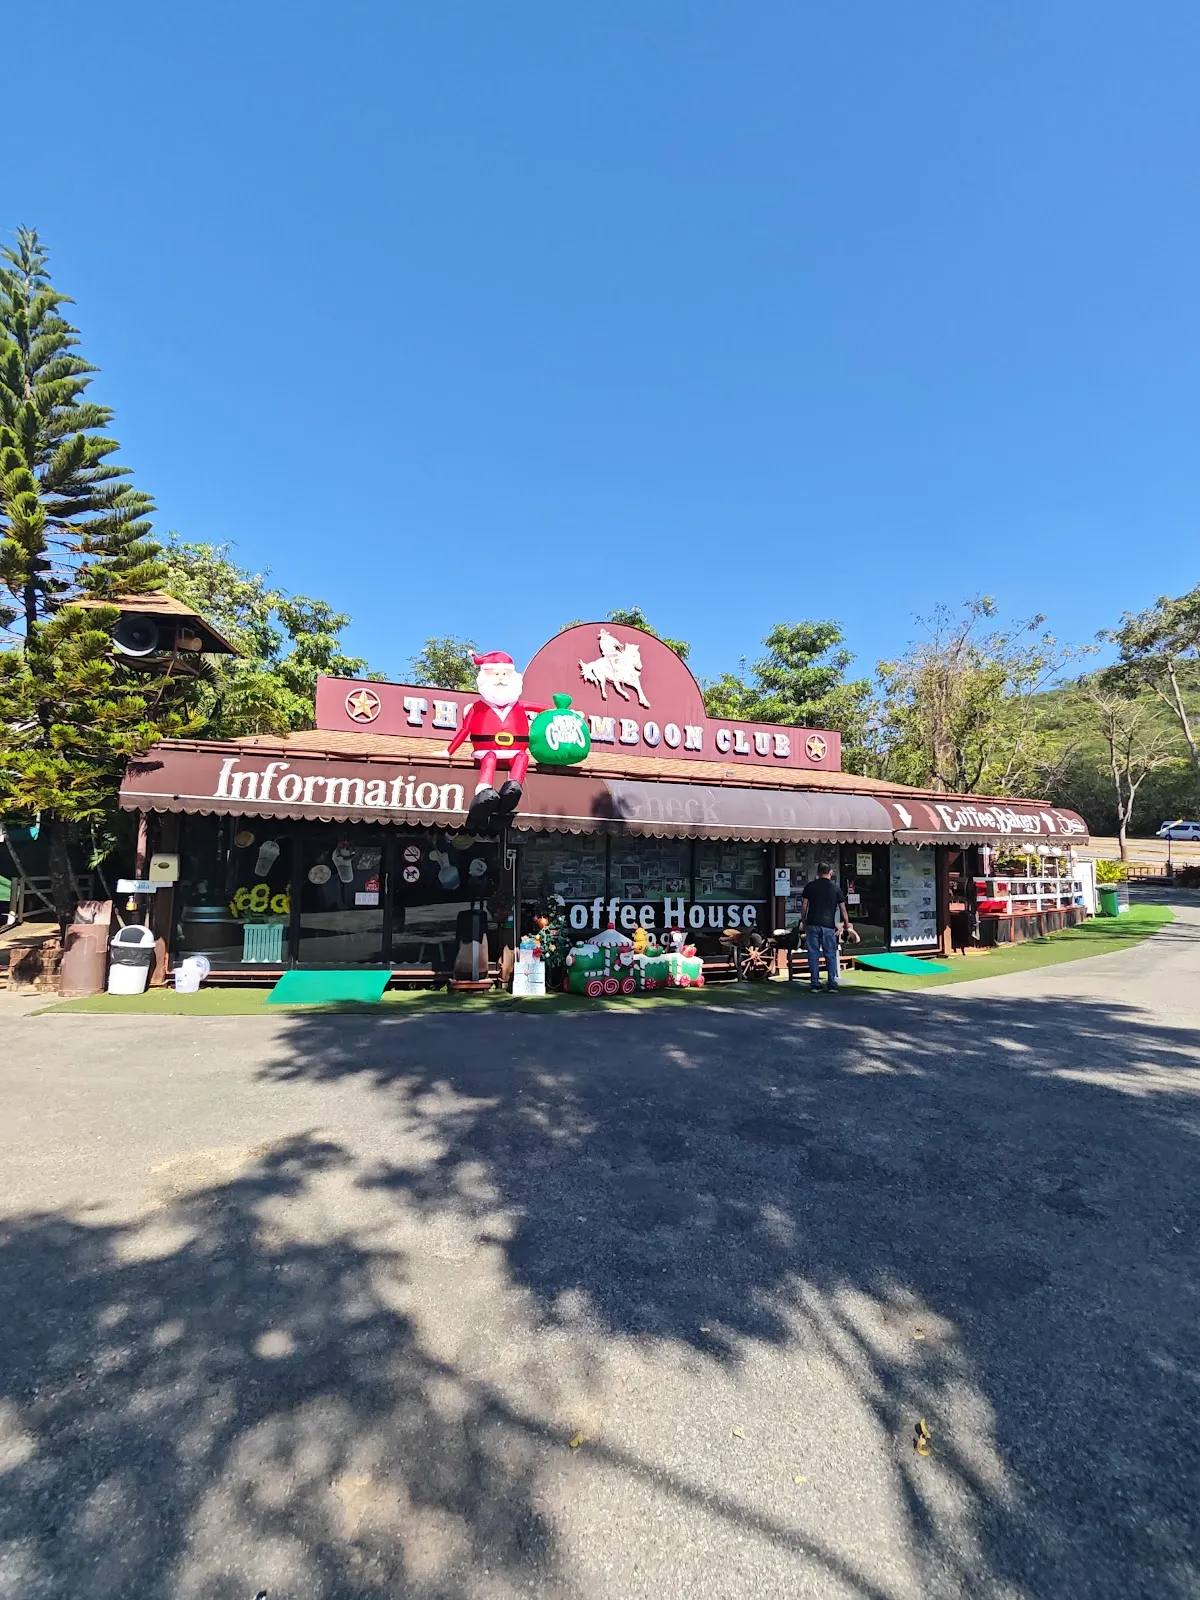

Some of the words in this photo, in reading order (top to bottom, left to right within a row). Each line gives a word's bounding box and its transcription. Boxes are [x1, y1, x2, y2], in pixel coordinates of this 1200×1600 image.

[716, 728, 790, 757] CLUB
[213, 758, 465, 811] Information
[988, 807, 1041, 833] Bakery
[556, 896, 656, 929] offee
[664, 897, 758, 928] House
